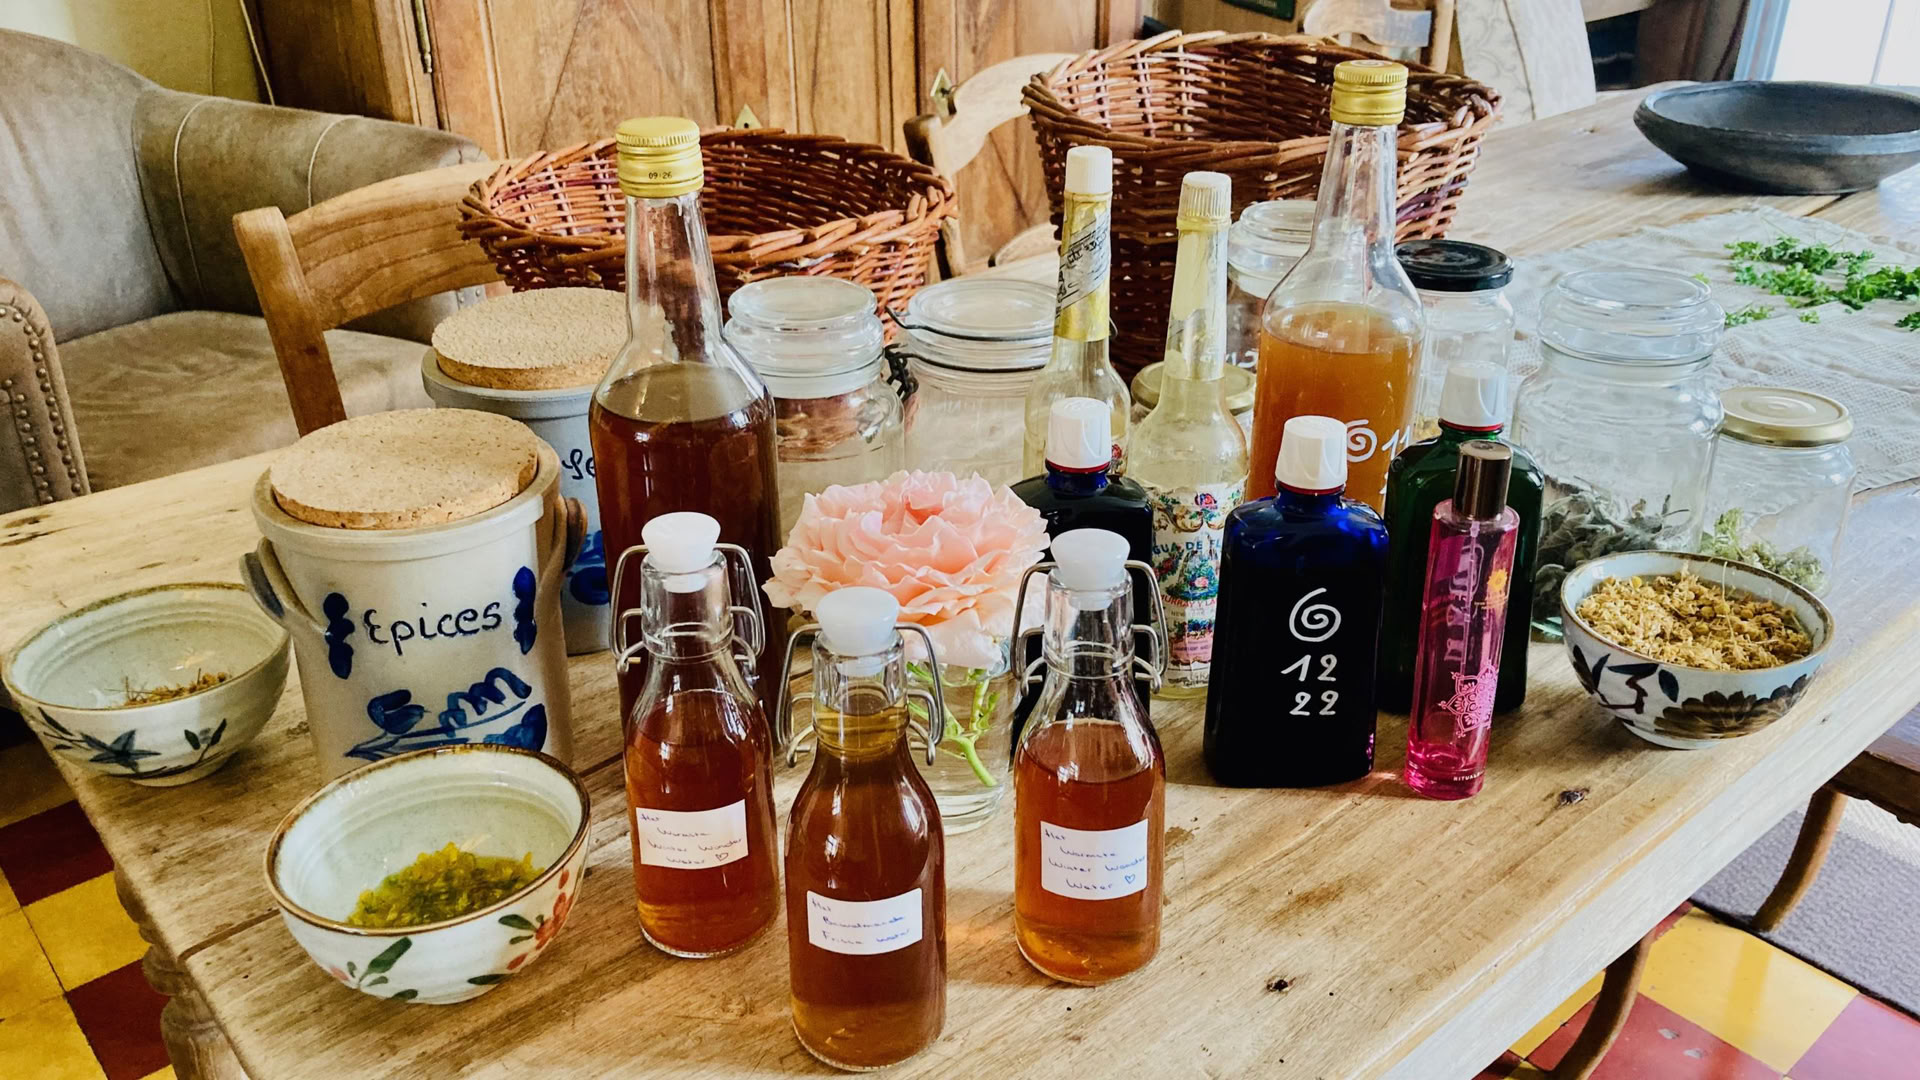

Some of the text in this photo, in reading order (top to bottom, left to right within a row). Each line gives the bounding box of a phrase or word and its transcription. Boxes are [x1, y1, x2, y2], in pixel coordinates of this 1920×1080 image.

[561, 448, 597, 480] Se
[1152, 537, 1222, 555] GUA DE FL
[363, 602, 502, 656] Epices
[1281, 654, 1337, 681] 12
[1289, 690, 1339, 716] 22
